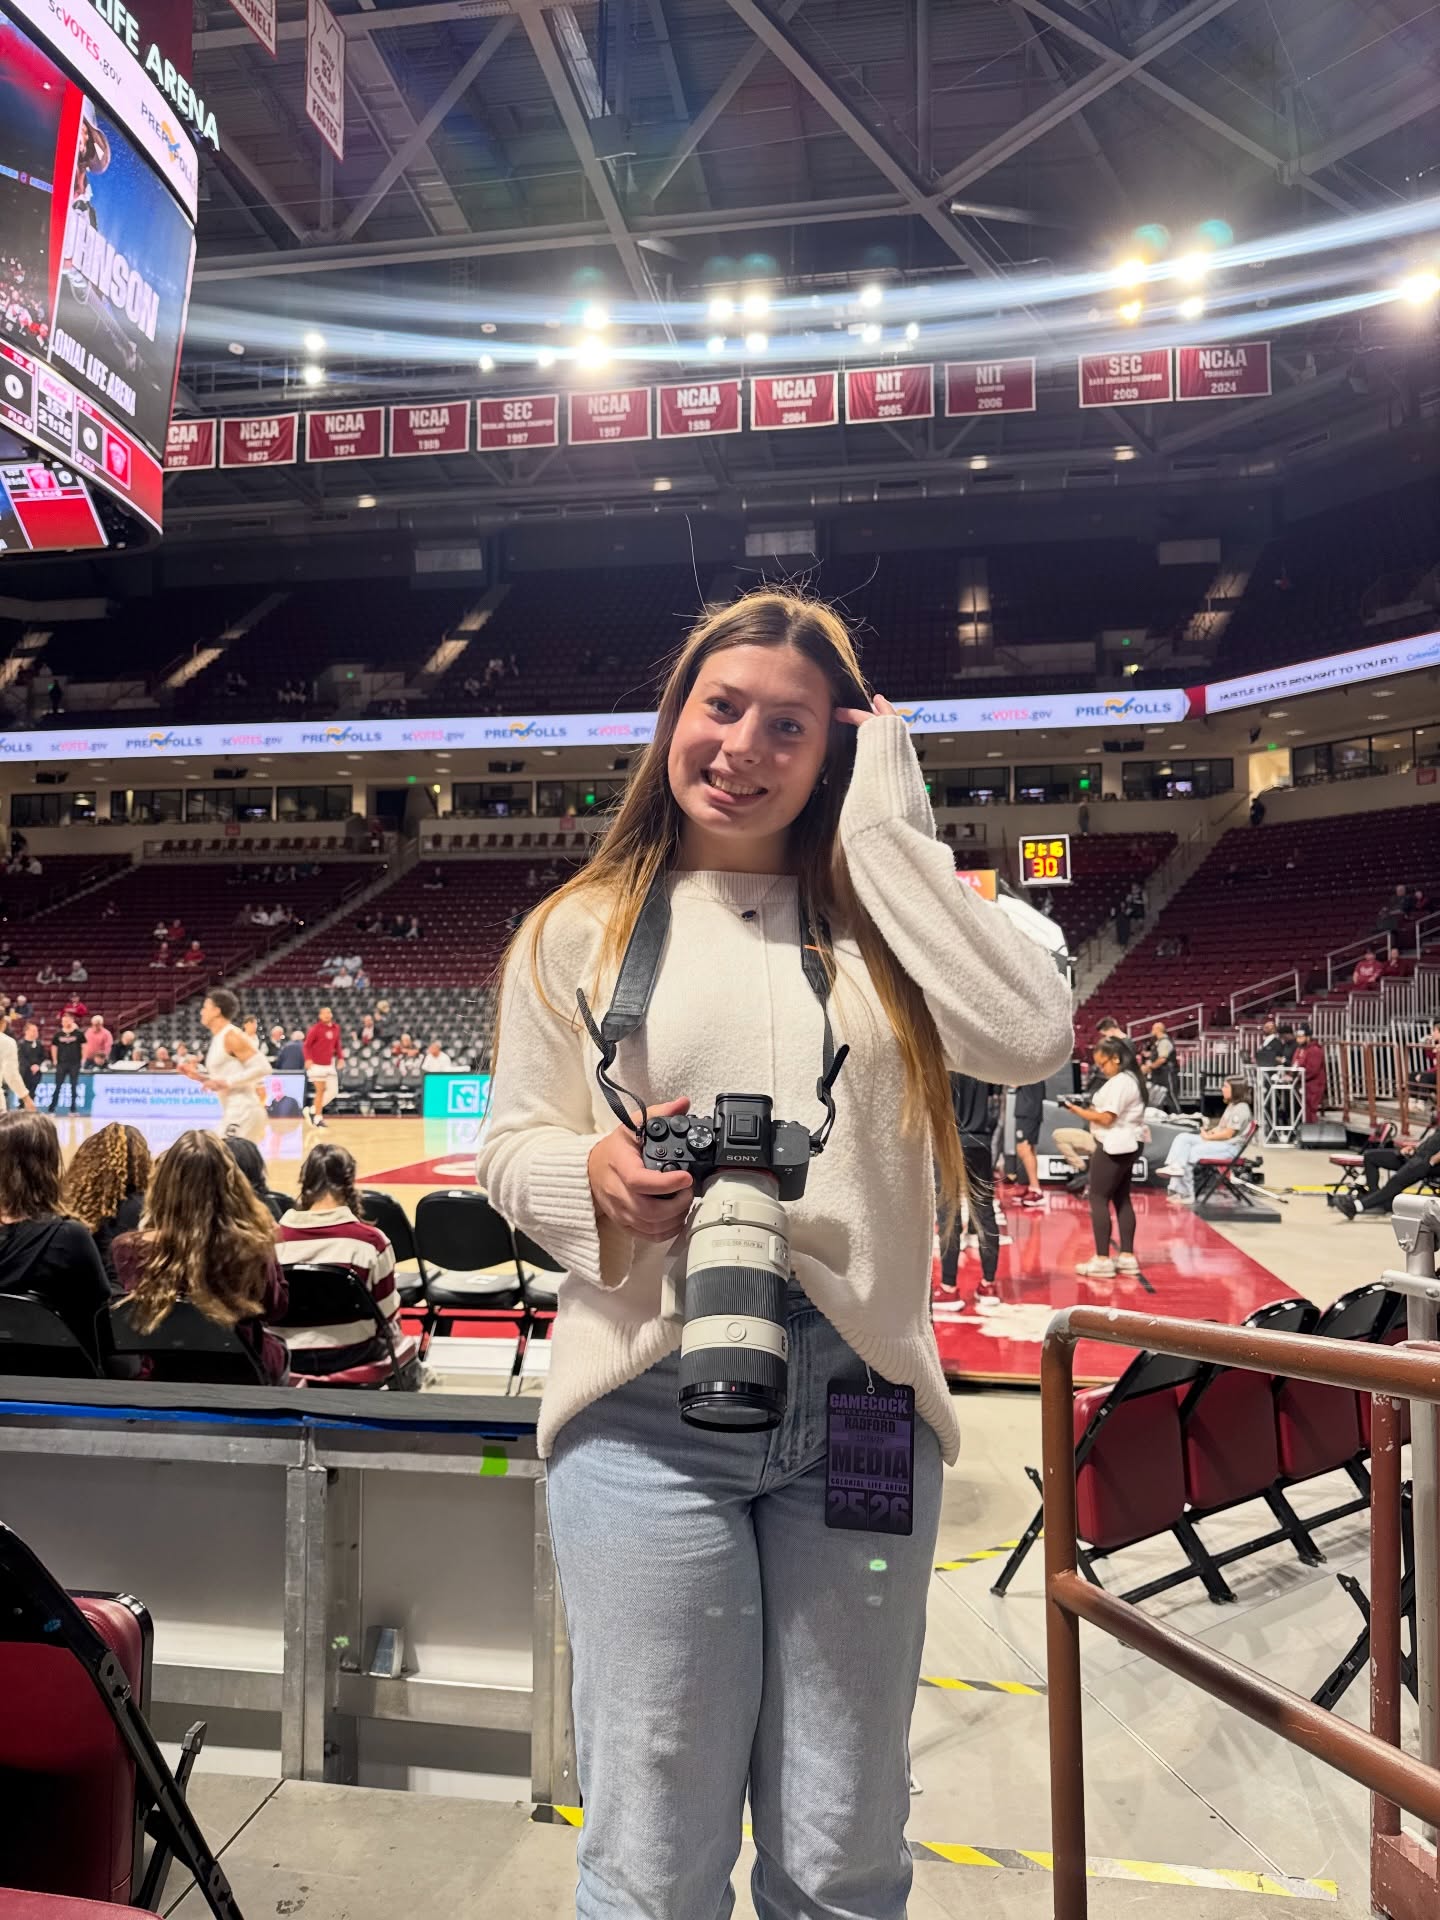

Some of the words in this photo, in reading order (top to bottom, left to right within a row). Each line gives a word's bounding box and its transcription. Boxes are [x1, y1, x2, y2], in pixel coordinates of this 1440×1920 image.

[249, 0, 274, 42] CHELL
[48, 3, 122, 86] scVOTES.gov
[145, 43, 220, 151] ARENA
[312, 99, 338, 146] FOSTER
[1108, 354, 1142, 376] SEC
[1199, 349, 1248, 369] NCAA
[50, 328, 86, 375] ONIAL
[86, 353, 108, 393] LIFE
[105, 371, 136, 417] ARENA
[875, 371, 903, 393] NIT
[975, 365, 1003, 385] NIT
[5, 374, 24, 400] 0
[676, 386, 721, 408] NCAA
[772, 378, 817, 400] NCAA
[1112, 388, 1139, 400] 2009
[1210, 382, 1237, 394] 2024
[503, 401, 532, 421] SEC
[587, 394, 631, 414] NCAA
[878, 404, 902, 417] 2005
[977, 397, 1003, 409] 2006
[325, 413, 365, 433] NCAA
[409, 408, 450, 428] NCAA
[782, 412, 807, 424] 2004
[83, 427, 98, 451] 0
[168, 425, 198, 443] CAA
[240, 421, 279, 440] NCAA
[507, 433, 528, 444] 1997
[599, 427, 621, 438] 1997
[248, 451, 268, 463] 1973
[334, 444, 355, 456] 1974
[1219, 688, 1255, 701] HUSTLE
[1257, 681, 1287, 694] STATE
[1289, 670, 1337, 686] BROUGHT
[1339, 666, 1354, 676] TO
[1355, 660, 1378, 672] YOU
[980, 708, 1052, 722] scVOTES.gov
[1033, 857, 1058, 877] 30
[105, 1087, 152, 1095] PERSONAL
[154, 1087, 186, 1095] INJURY
[109, 1096, 147, 1104] SERVING
[150, 1096, 180, 1104] SOUTH
[830, 1393, 908, 1414] GAMECOCK
[894, 1389, 907, 1398] 011
[844, 1417, 896, 1433] RADFORD
[831, 1446, 909, 1479] MEDIA
[831, 1478, 864, 1488] COLONIAL
[867, 1480, 882, 1489] LIFE
[885, 1482, 908, 1492] ARENA
